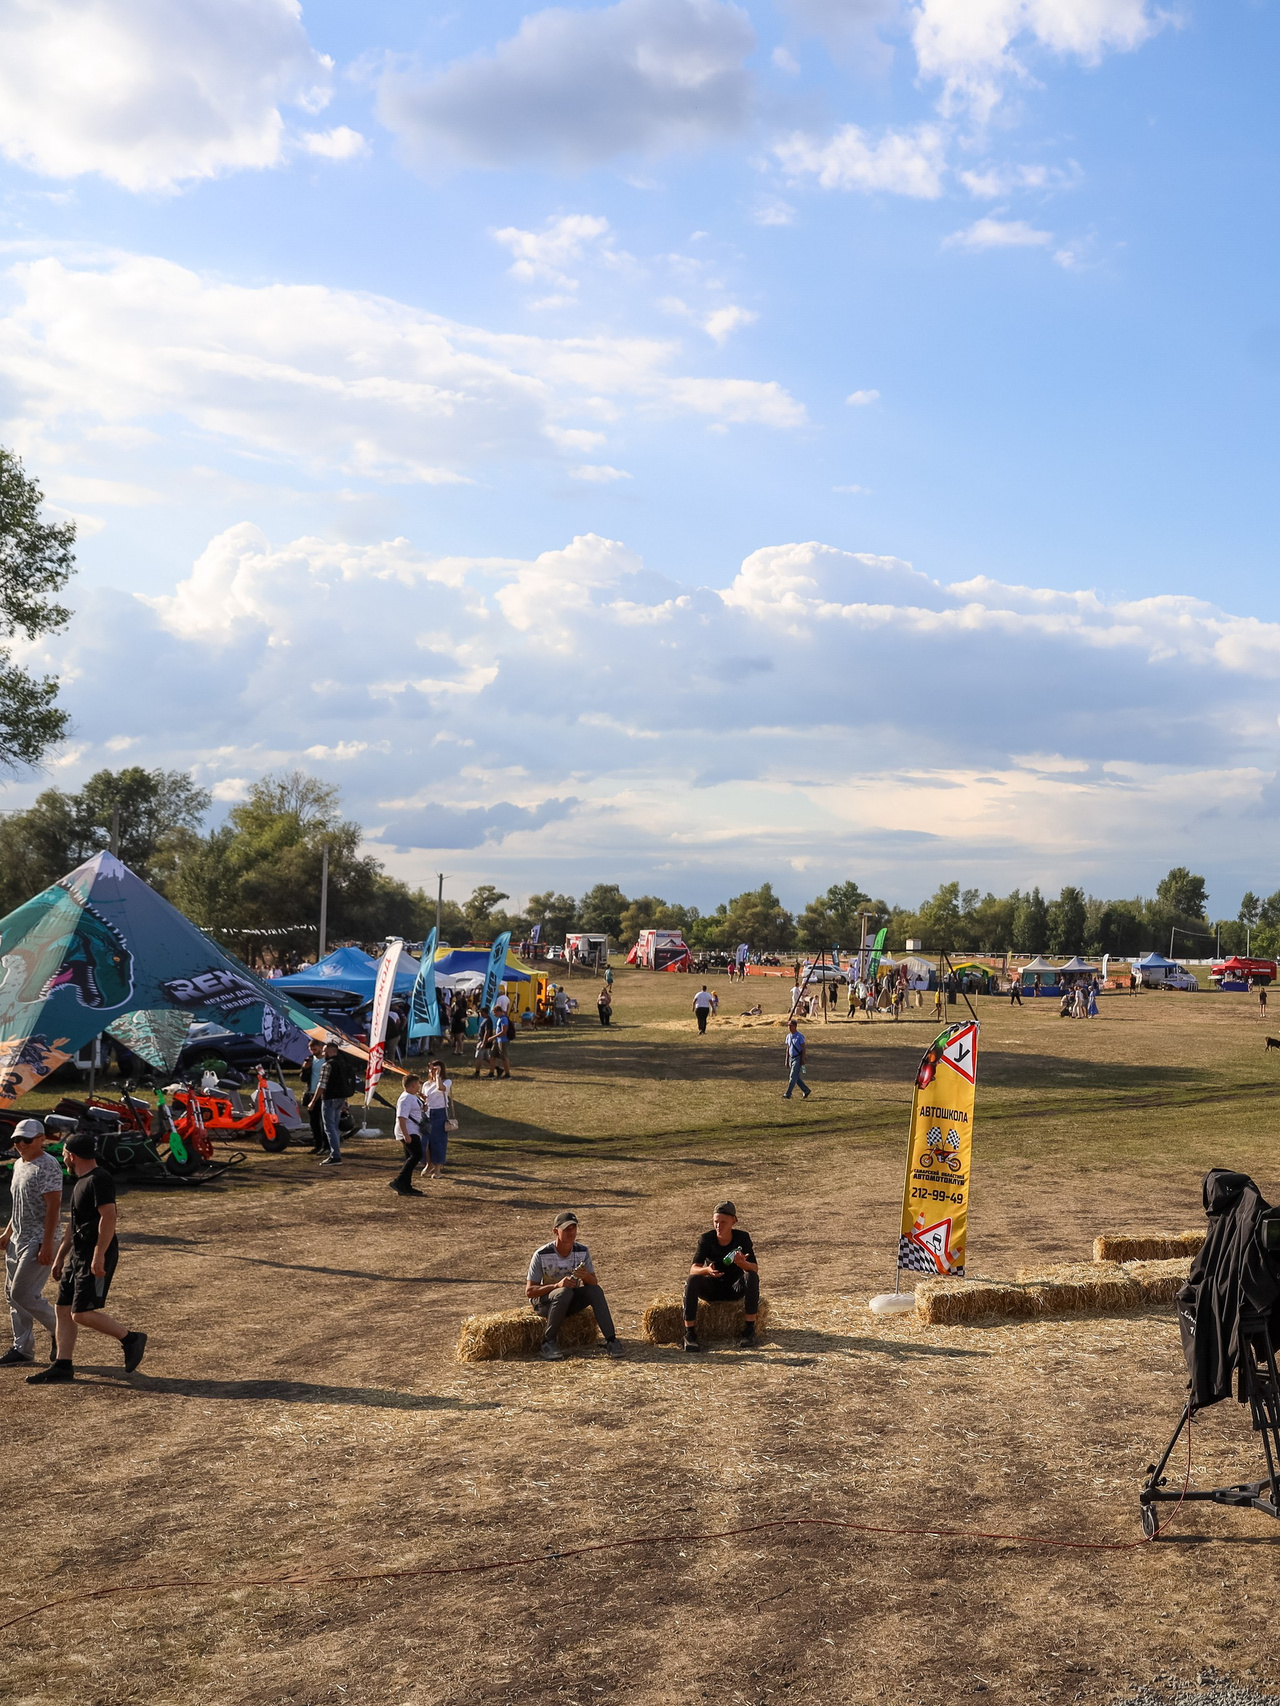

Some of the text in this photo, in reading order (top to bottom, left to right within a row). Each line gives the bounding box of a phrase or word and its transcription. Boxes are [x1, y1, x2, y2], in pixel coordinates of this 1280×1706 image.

[204, 992, 235, 1005] чехлы
[220, 997, 258, 1010] квадро
[954, 1043, 970, 1062] У
[920, 1106, 968, 1123] АВТОШКОЛА
[913, 1173, 965, 1186] АВТОМОТОКЛУБ
[912, 1187, 963, 1204] 212-99-49
